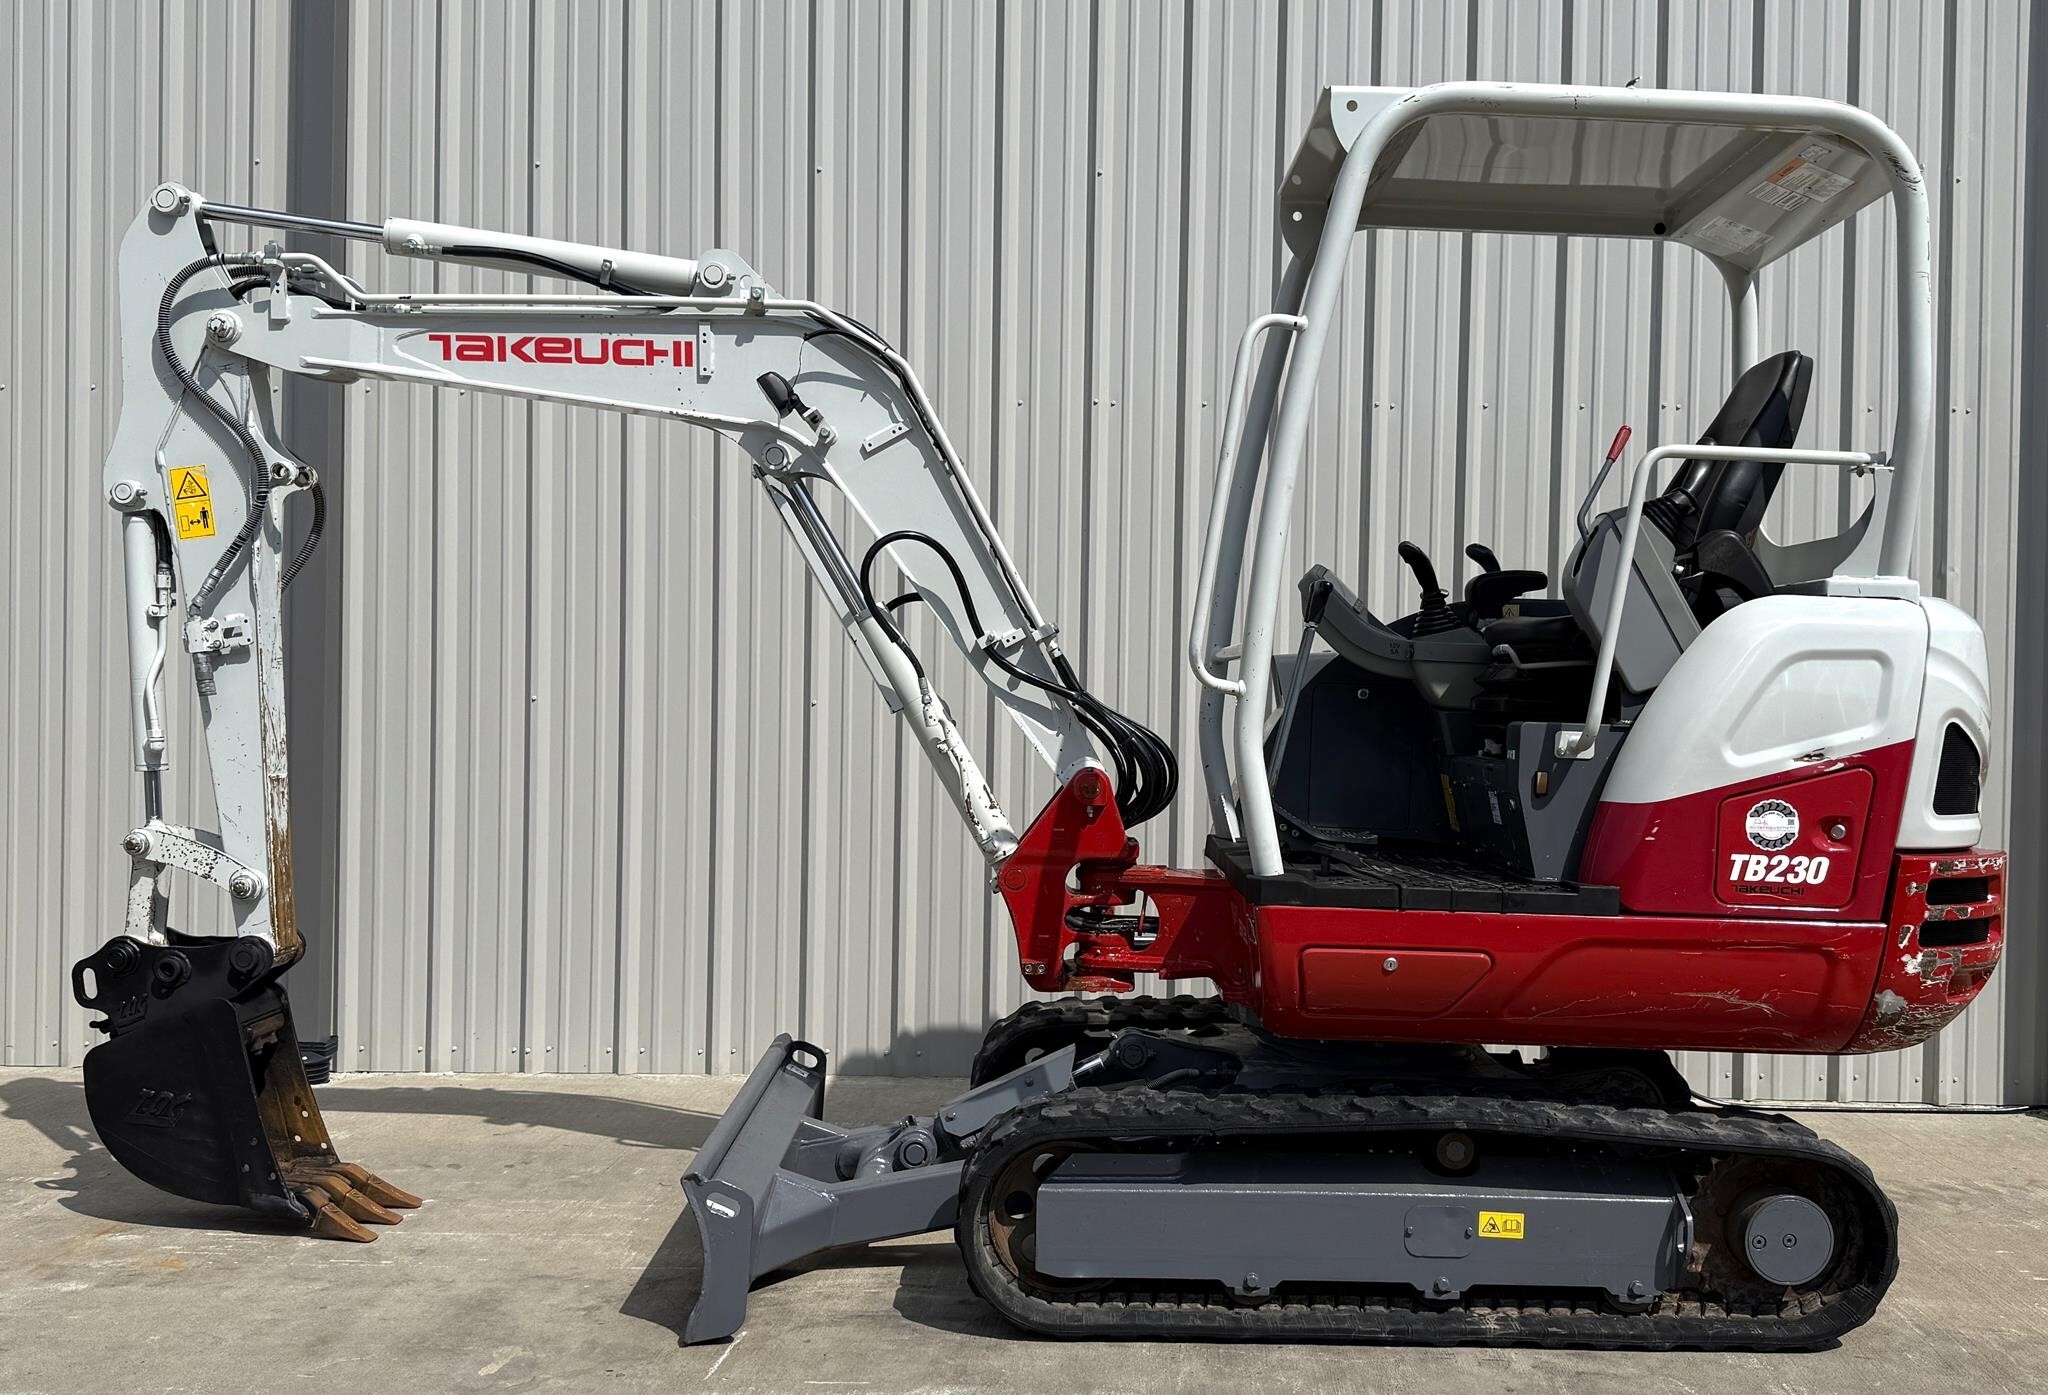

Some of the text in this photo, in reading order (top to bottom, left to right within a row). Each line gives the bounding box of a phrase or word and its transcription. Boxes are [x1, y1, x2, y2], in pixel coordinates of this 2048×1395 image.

[428, 334, 694, 368] TAKEUCHI
[1729, 853, 1830, 884] TB230
[1731, 884, 1805, 896] TAKEUCHI
